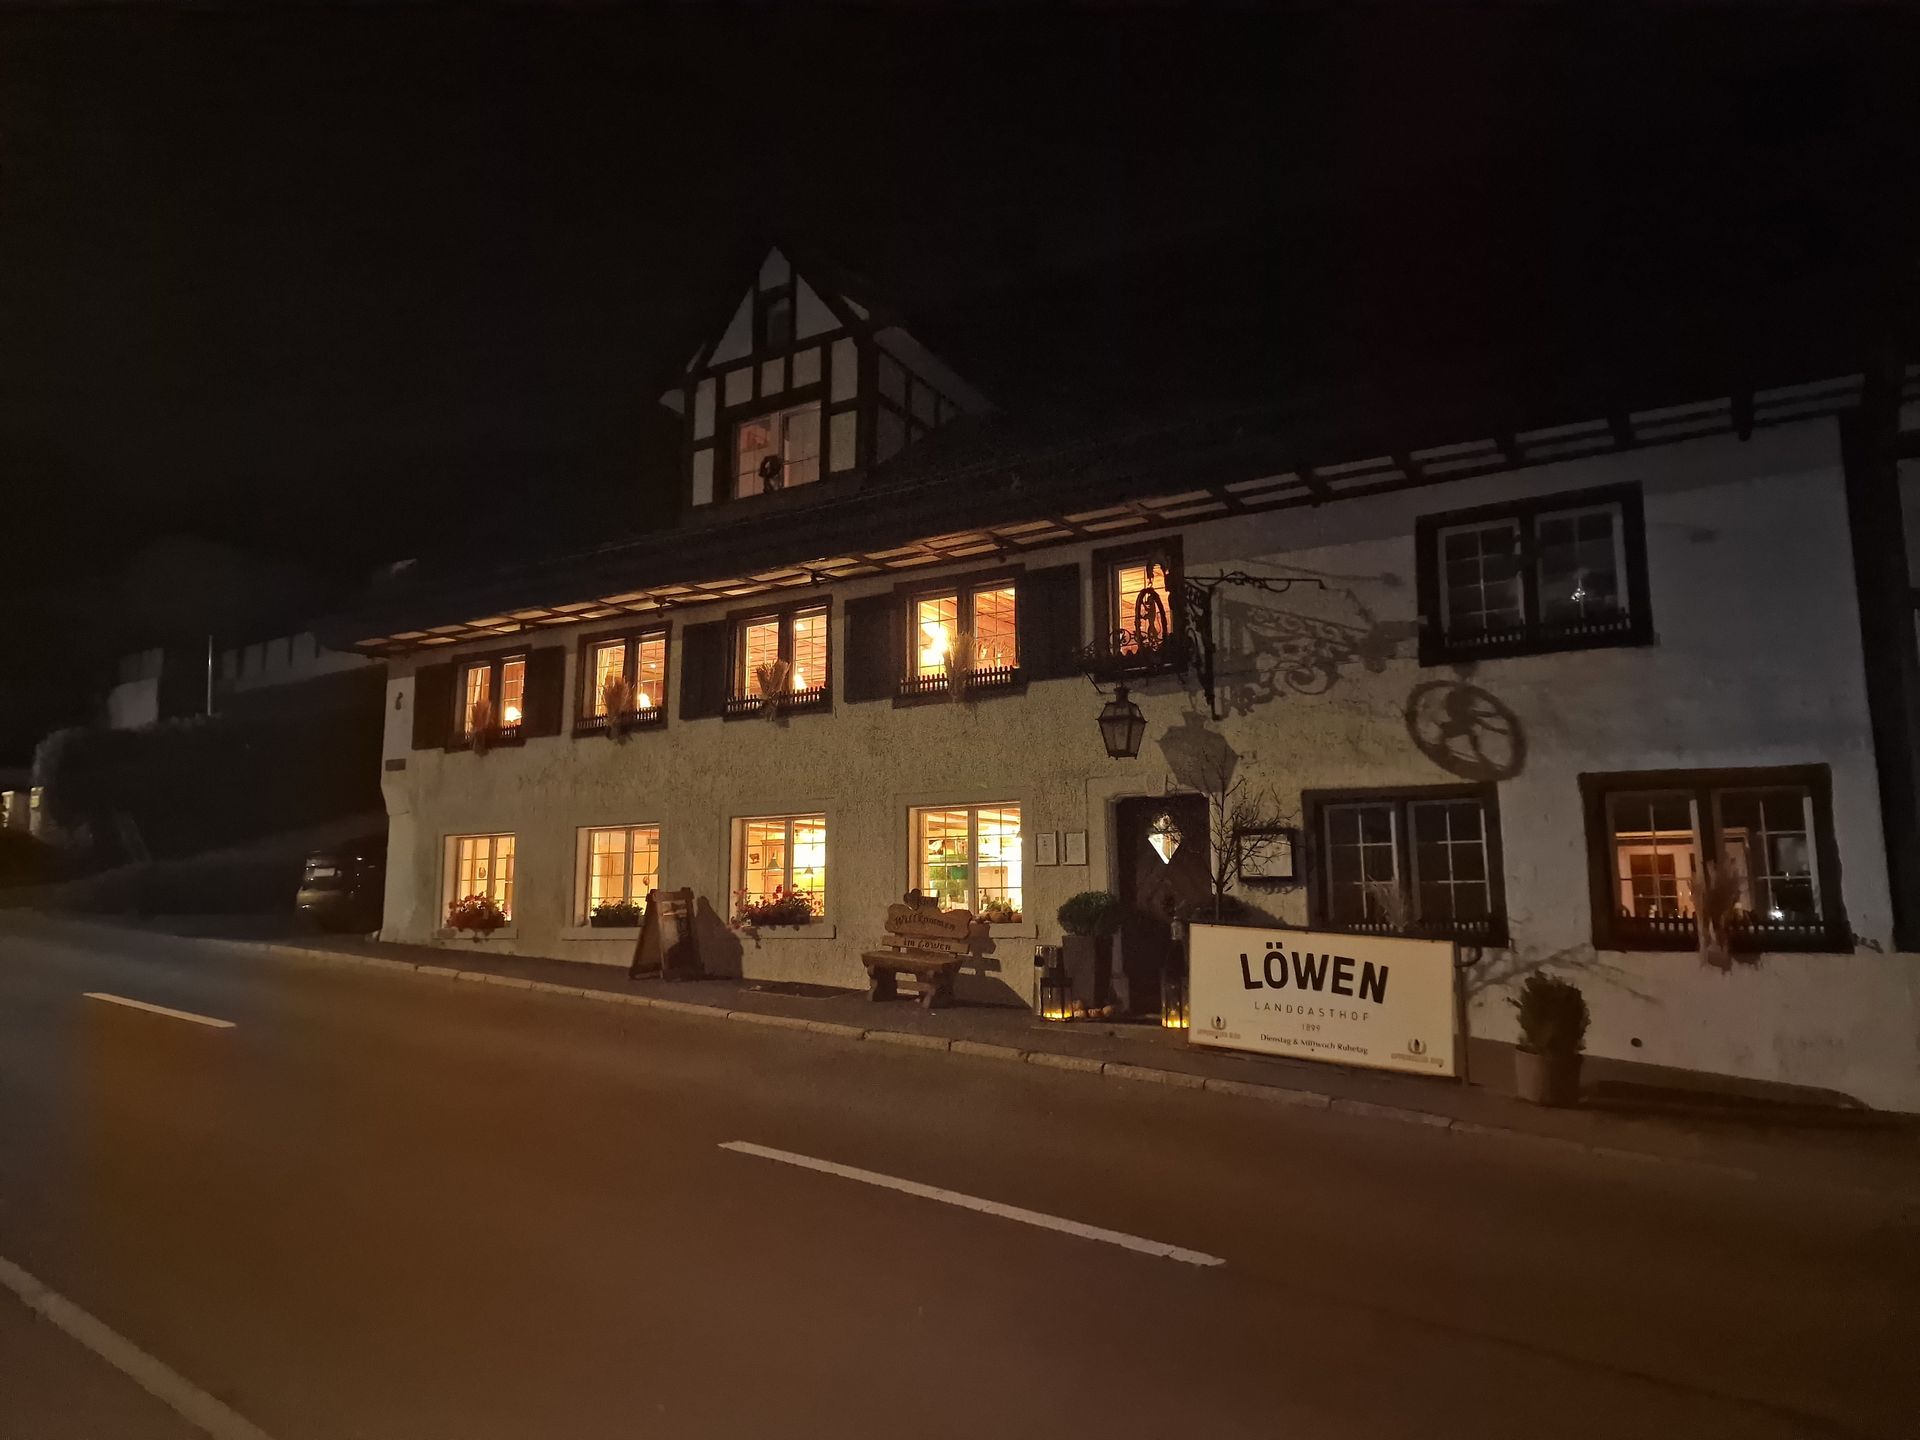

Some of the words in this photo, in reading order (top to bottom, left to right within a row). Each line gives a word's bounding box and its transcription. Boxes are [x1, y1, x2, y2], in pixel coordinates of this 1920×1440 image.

[1240, 942, 1389, 1004] LÖWEN
[1254, 1001, 1369, 1021] LANDGASTHOF
[1301, 1023, 1321, 1032] 1899
[1260, 1033, 1291, 1046] Dienstag
[1293, 1038, 1299, 1046] &
[1337, 1043, 1369, 1055] Ruhetag
